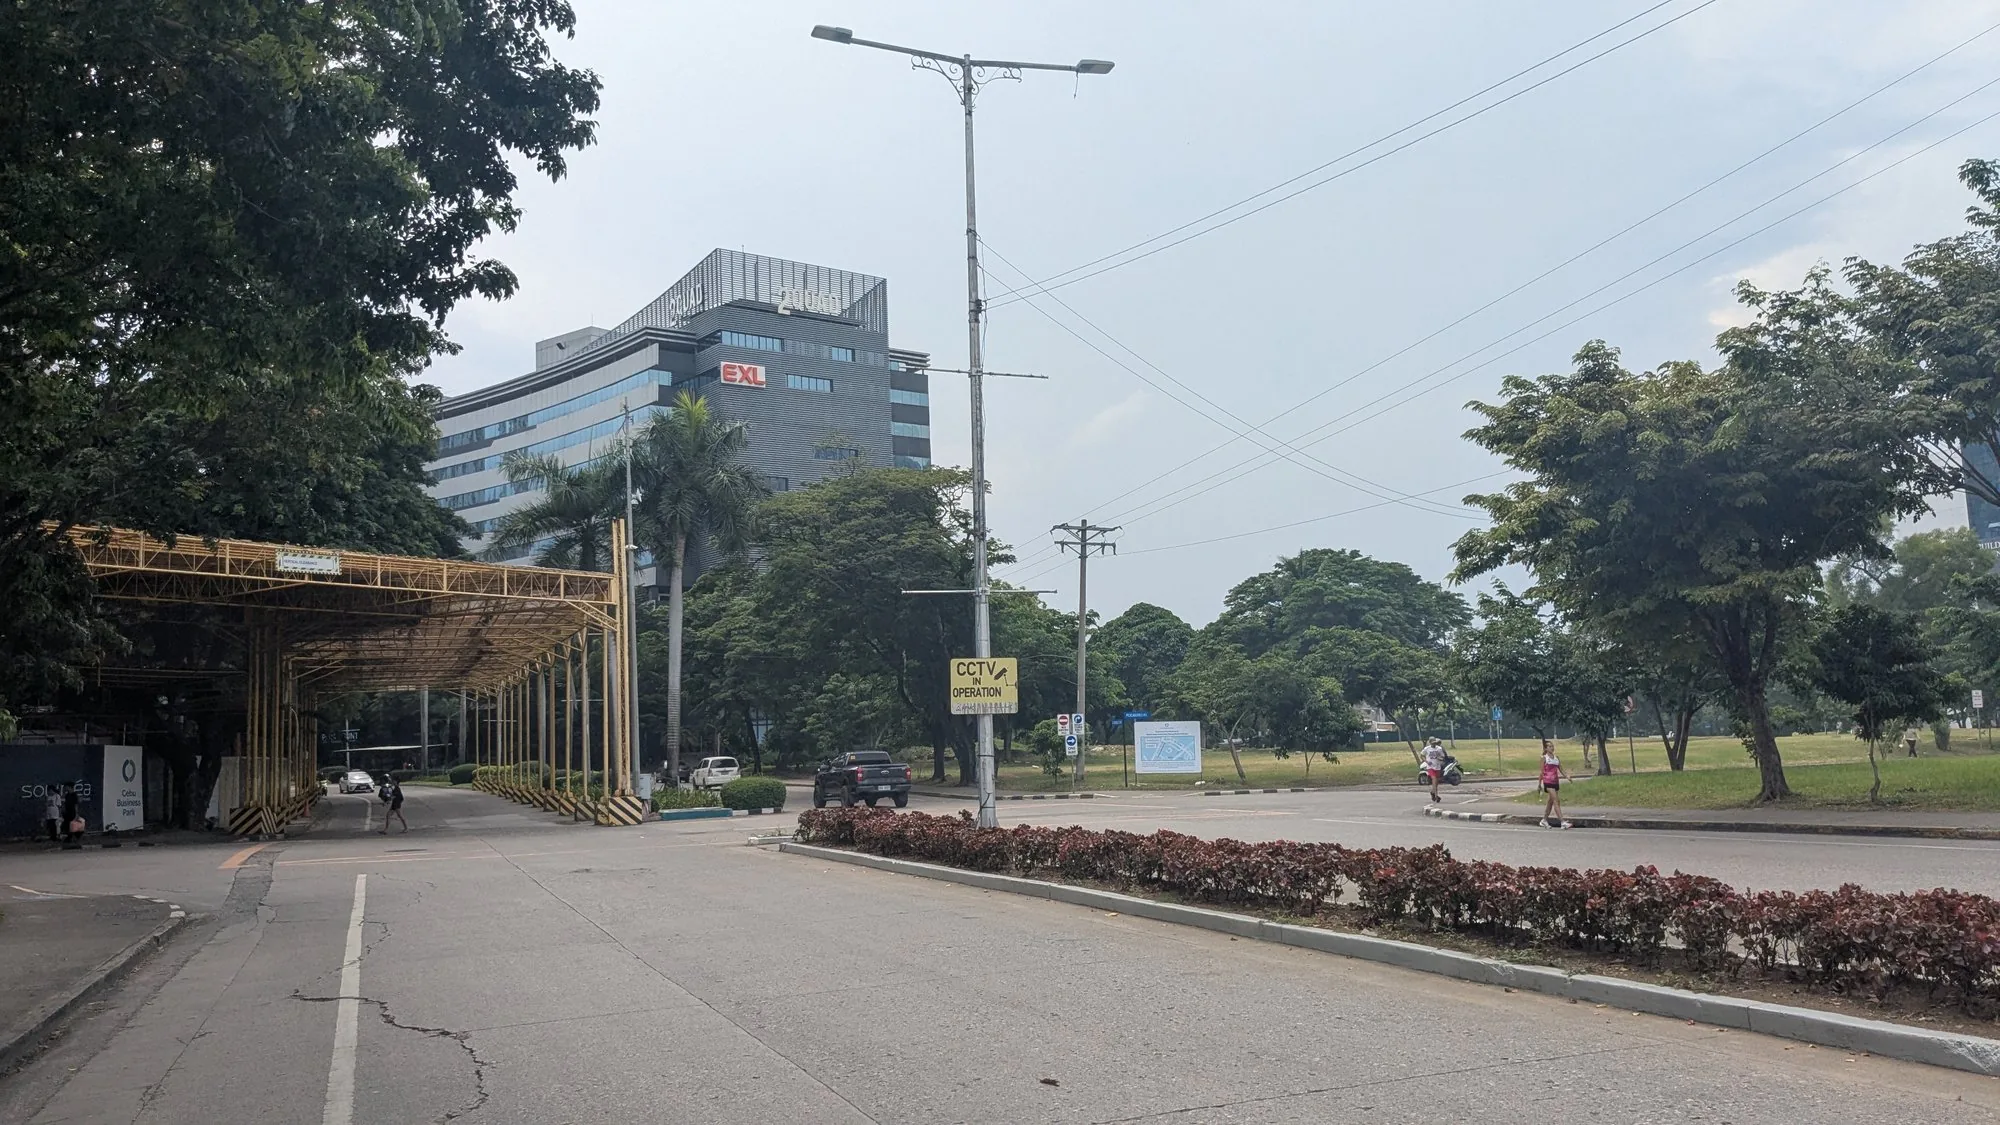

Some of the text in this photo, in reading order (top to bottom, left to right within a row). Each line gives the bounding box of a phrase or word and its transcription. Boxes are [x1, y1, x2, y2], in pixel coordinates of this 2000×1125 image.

[669, 284, 703, 327] 2QUAD
[778, 286, 841, 316] 2QUAD
[723, 364, 767, 386] EXL
[957, 661, 996, 676] CCTV
[972, 677, 982, 686] IN
[952, 687, 1002, 698] OPERATION
[121, 789, 137, 797] Cebu
[116, 799, 142, 807] Business
[122, 808, 136, 816] Park
